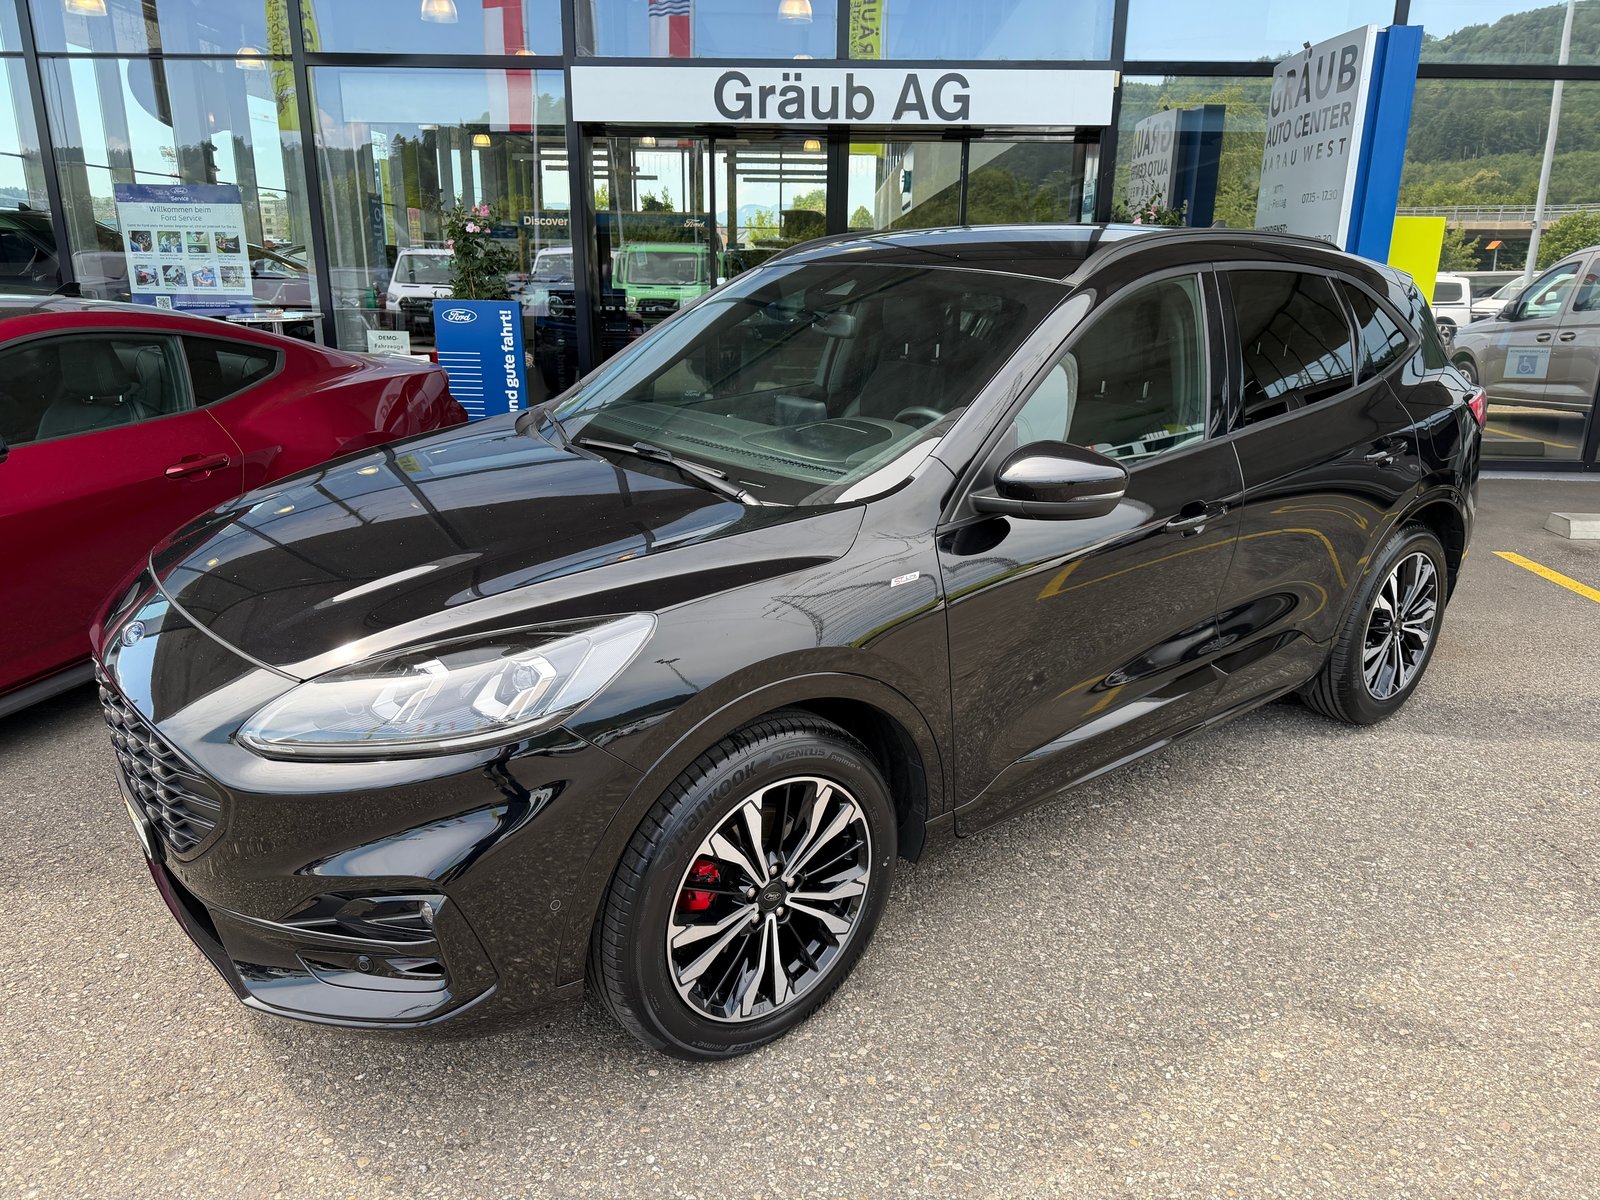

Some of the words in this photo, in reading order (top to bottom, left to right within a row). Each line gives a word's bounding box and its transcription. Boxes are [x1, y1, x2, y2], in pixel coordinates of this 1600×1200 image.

[714, 71, 875, 121] Gräub
[892, 72, 971, 121] AG
[1270, 41, 1359, 118] GRÄUB
[1265, 119, 1292, 150] AUTO
[1294, 101, 1352, 139] CENTER
[1263, 149, 1298, 174] AARAU
[1303, 138, 1347, 162] WEST
[149, 206, 192, 214] Willkommen
[523, 215, 569, 226] Discover
[447, 310, 472, 322] Ford
[499, 309, 514, 353] fahrt!
[374, 343, 404, 351] Fahrzeuge
[503, 354, 520, 389] gute
